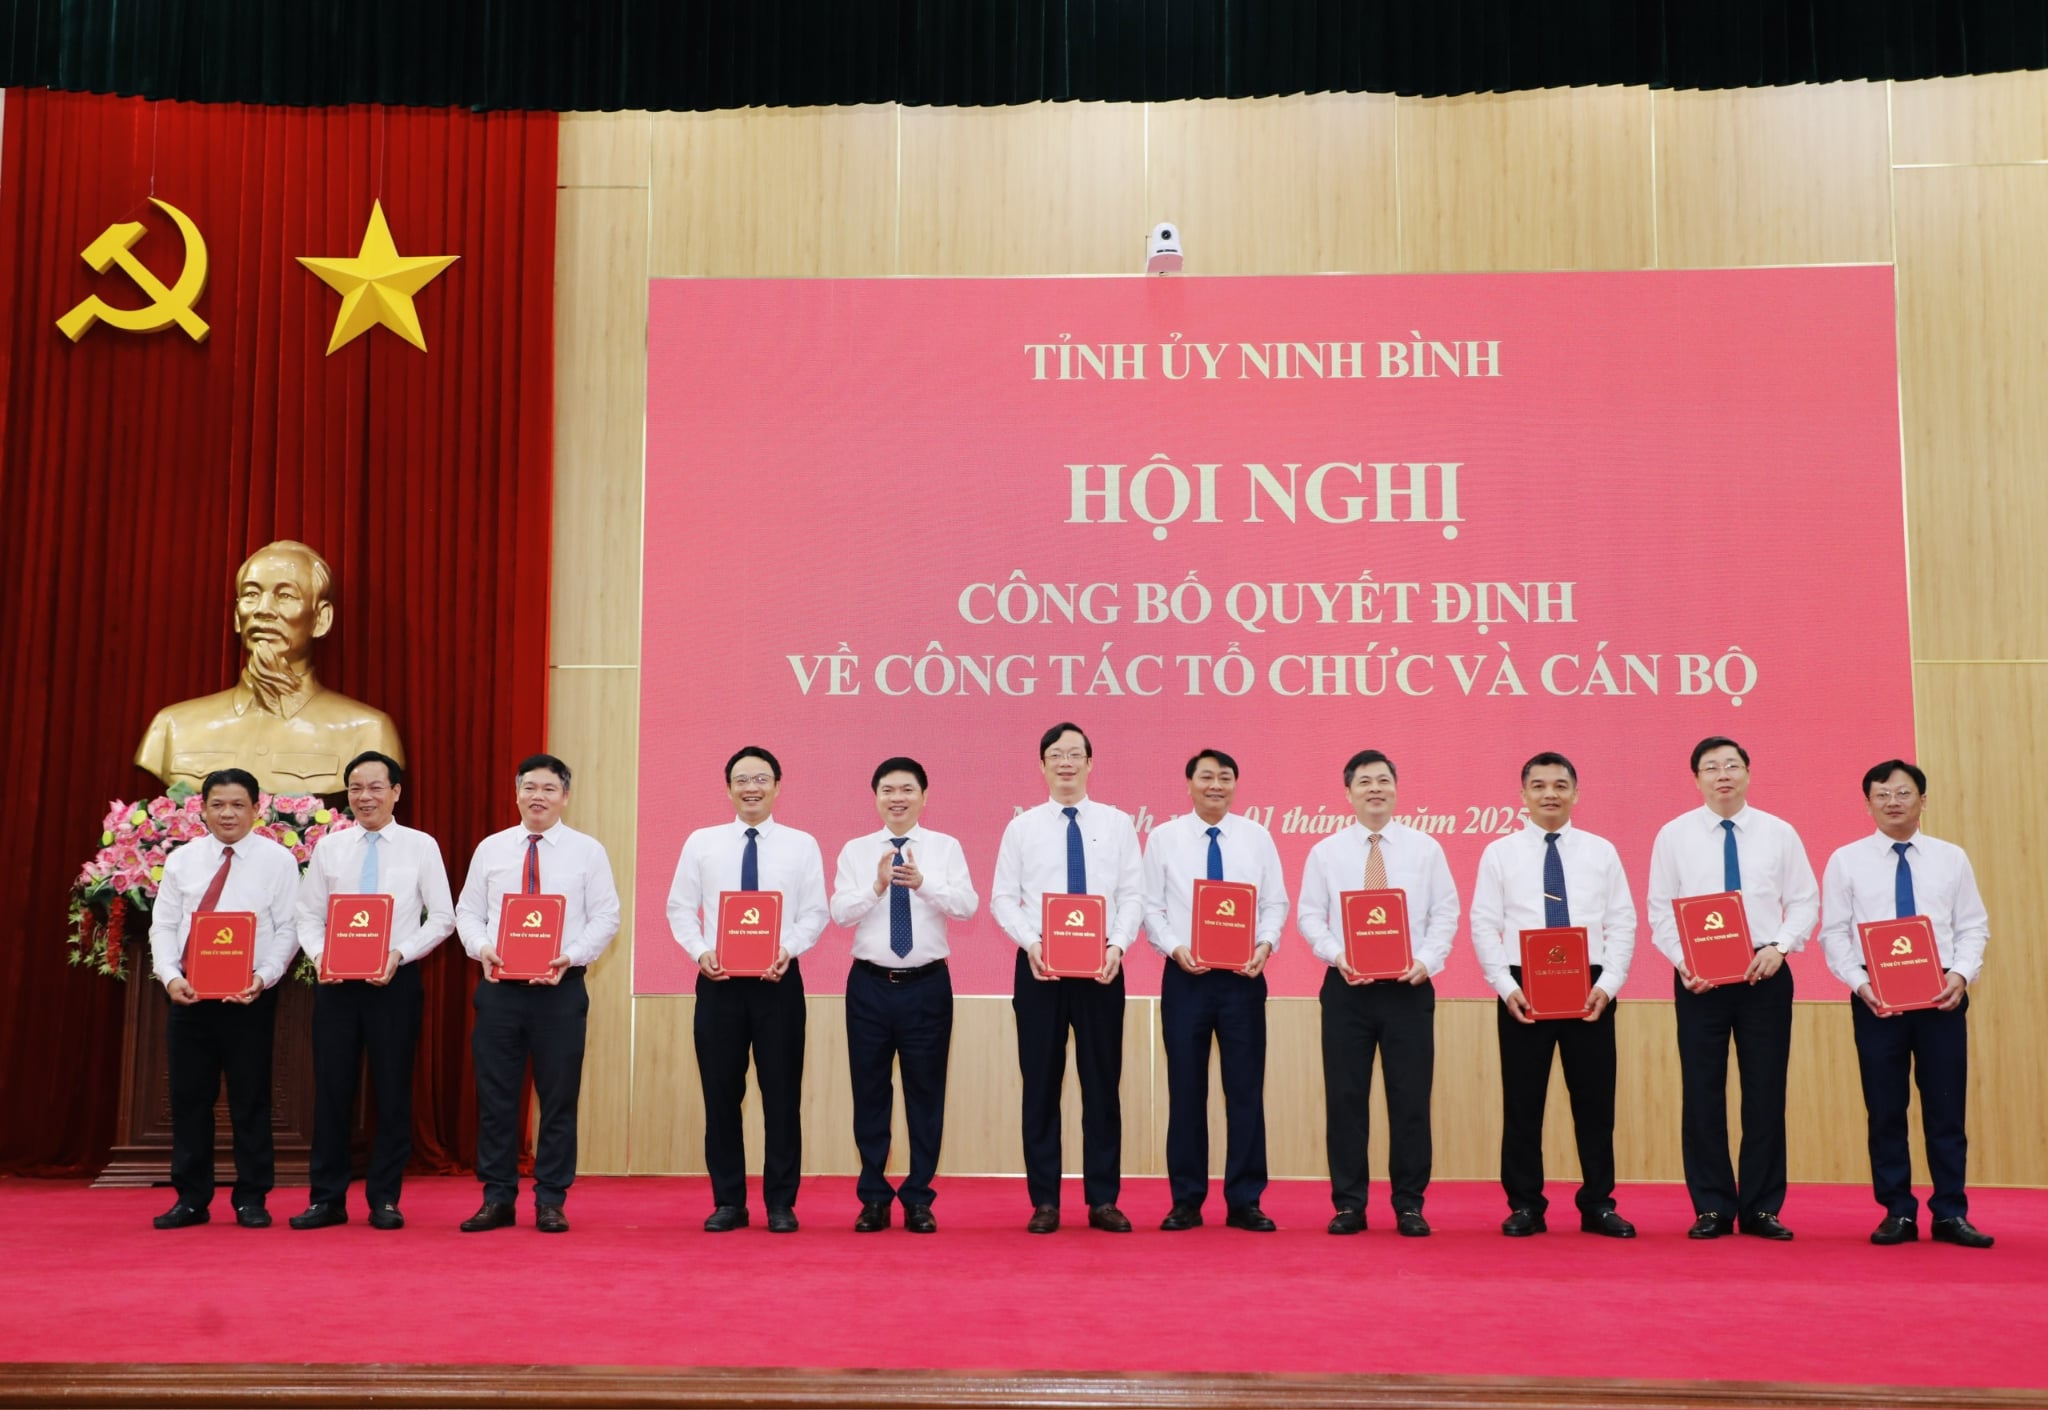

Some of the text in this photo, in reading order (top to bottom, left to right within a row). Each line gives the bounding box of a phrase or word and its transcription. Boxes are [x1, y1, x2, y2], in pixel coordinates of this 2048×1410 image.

[1024, 330, 1502, 380] TỈNH ỦY NINH BÌNH
[1063, 452, 1466, 541] HỘI NGHỊ
[958, 569, 1578, 635] CÔNG BỐ QUYẾT ĐỊNH
[785, 640, 1758, 707] VỀ CÔNG TÁC TỔ CHỨC VÀ CÁN BỘ
[1461, 806, 1531, 834] 2025
